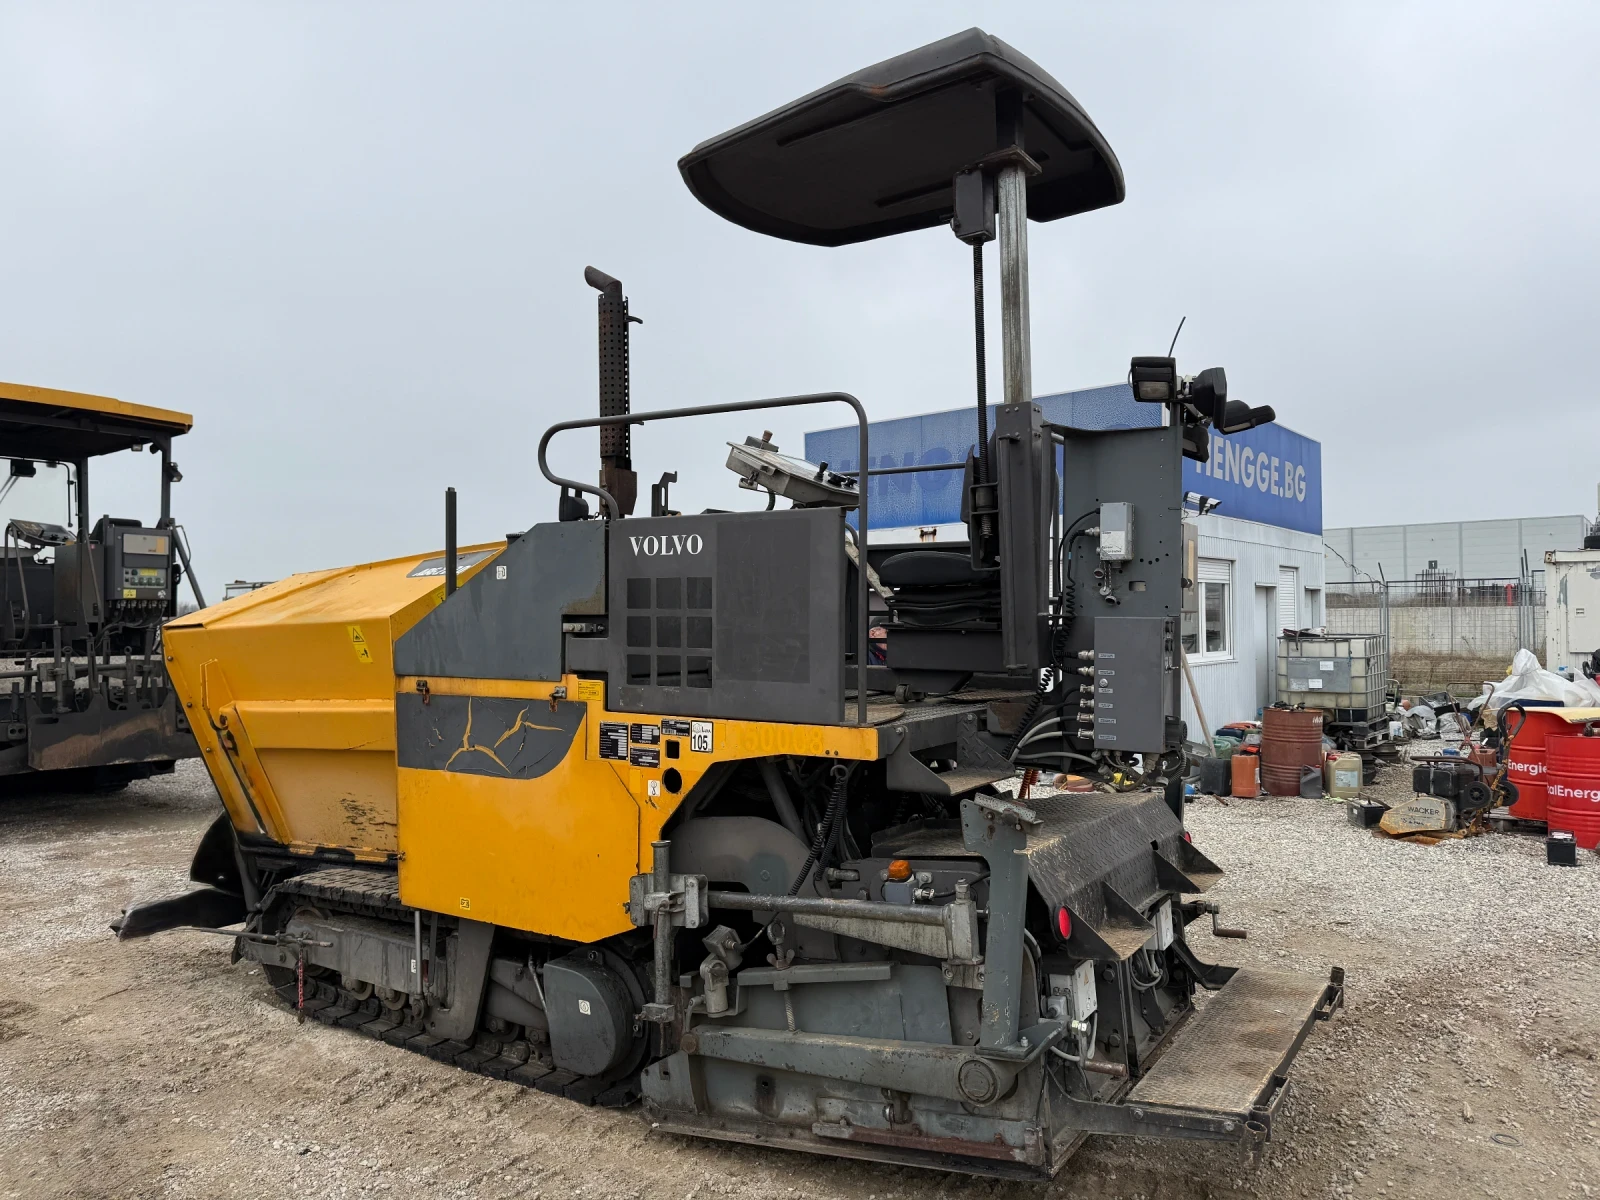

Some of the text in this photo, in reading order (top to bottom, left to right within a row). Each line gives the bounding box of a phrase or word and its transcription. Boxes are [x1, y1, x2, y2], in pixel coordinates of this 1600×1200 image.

[629, 533, 704, 556] VOLVO
[692, 734, 708, 751] 105
[1407, 806, 1440, 816] WACKER
